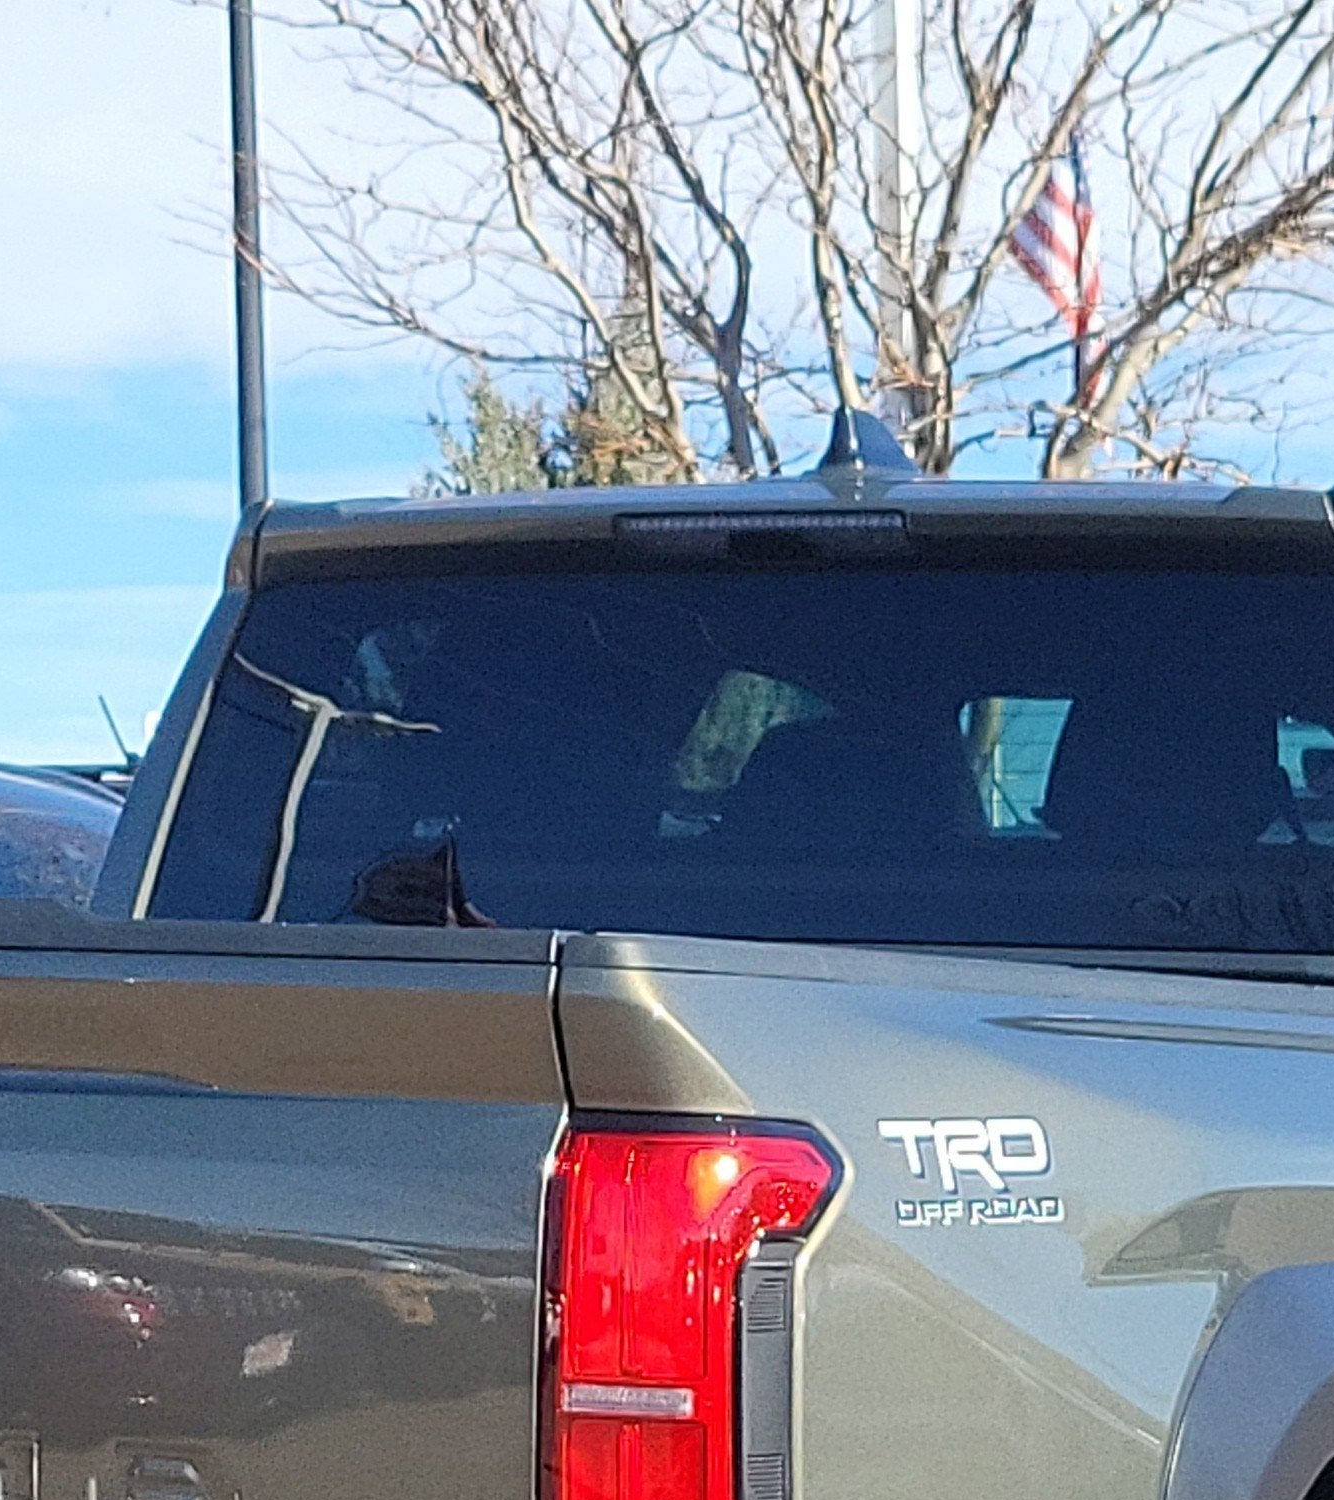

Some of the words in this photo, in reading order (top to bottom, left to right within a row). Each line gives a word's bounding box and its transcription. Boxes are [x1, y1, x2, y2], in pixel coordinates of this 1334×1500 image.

[876, 1116, 1053, 1194] TRD
[895, 1198, 965, 1227] OFF
[968, 1196, 1065, 1226] ROAD
